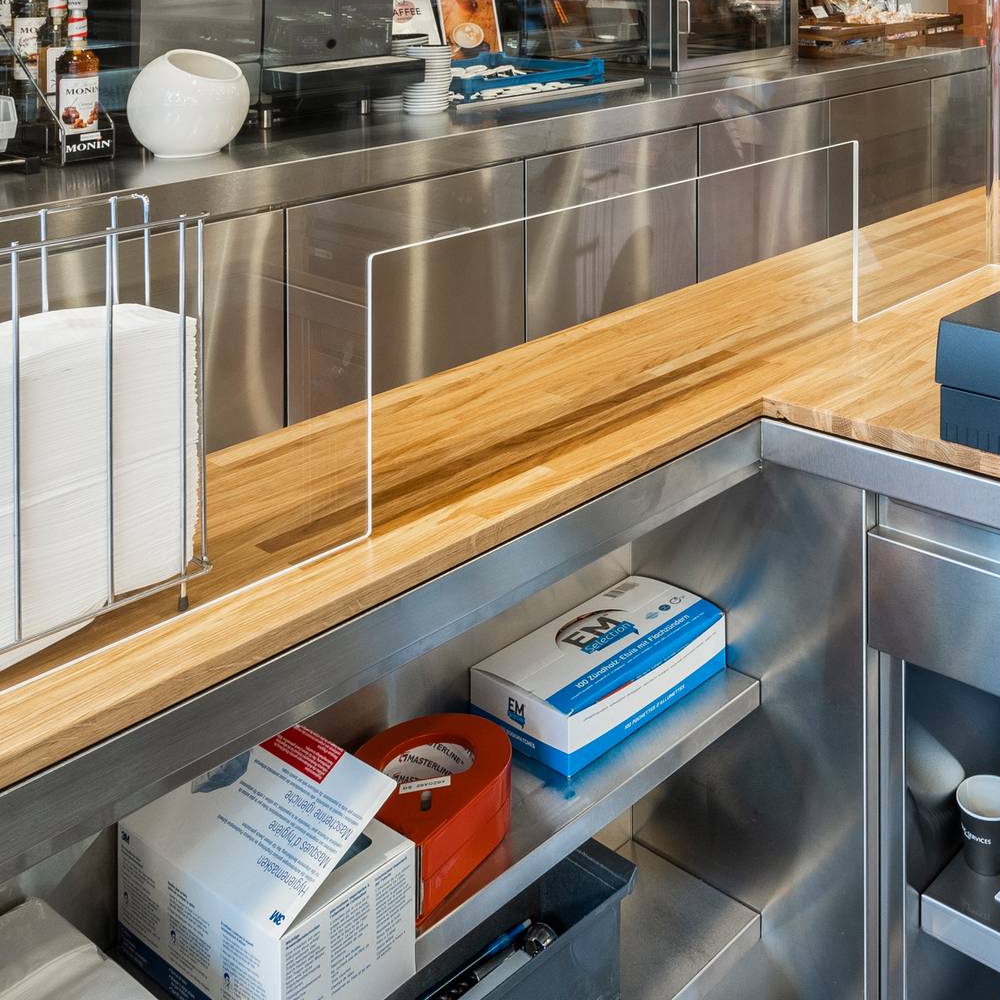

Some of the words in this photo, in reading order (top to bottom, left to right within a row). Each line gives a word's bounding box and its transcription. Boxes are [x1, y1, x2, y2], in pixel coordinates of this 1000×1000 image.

[393, 7, 422, 17] AFFEE
[66, 139, 111, 153] MONIN
[561, 612, 622, 650] EM
[585, 621, 631, 654] Selection
[574, 677, 589, 690] 100
[588, 648, 637, 682] Zündholz-Etuis
[636, 641, 650, 654] mit
[648, 613, 691, 645] Flachzündern
[508, 696, 525, 718] EM
[284, 790, 315, 816] igieniche
[121, 830, 130, 845] 3M
[268, 820, 300, 847] d'hygiène
[314, 808, 353, 841] Mascherine
[300, 841, 332, 869] Masques
[257, 854, 310, 898] Hygienemasken
[269, 909, 286, 926] 3M
